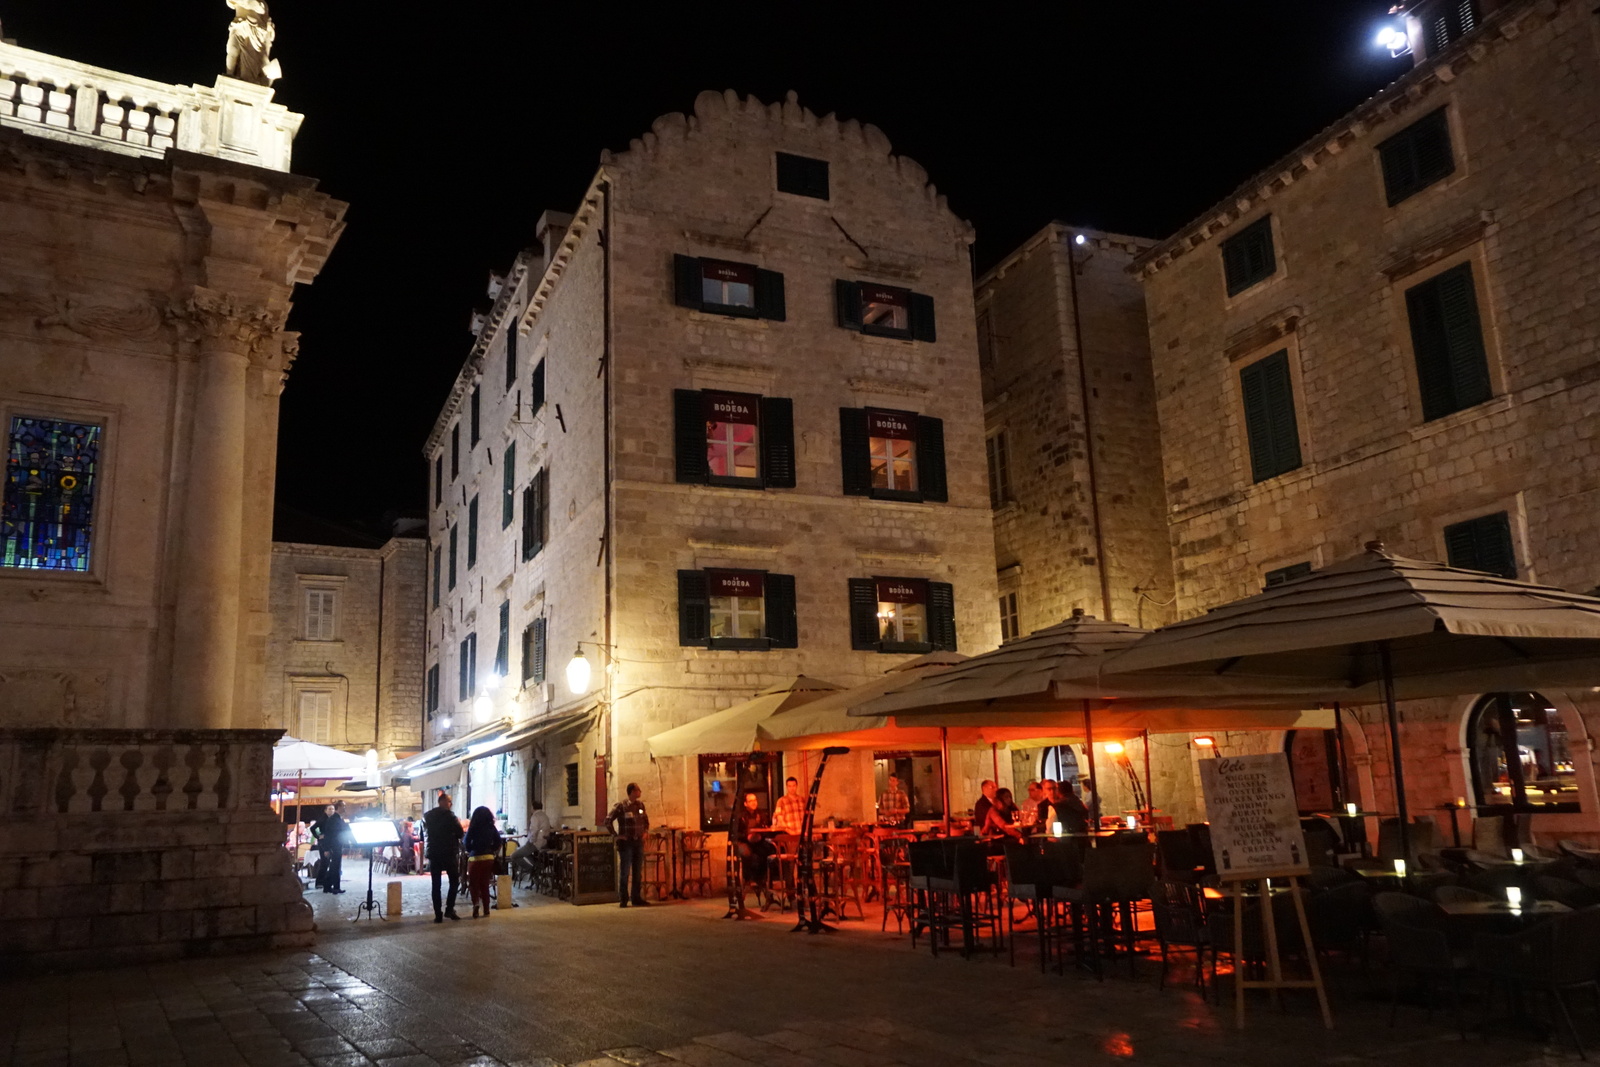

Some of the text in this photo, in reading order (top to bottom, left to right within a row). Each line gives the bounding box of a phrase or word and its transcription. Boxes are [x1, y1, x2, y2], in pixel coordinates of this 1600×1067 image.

[713, 403, 749, 414] BODEGA
[876, 420, 908, 431] BODEGA
[722, 579, 750, 587] BODEGA
[888, 587, 914, 595] BODEGA
[1225, 773, 1267, 782] NUGGETS
[1227, 780, 1267, 789] MUSSELS
[1228, 787, 1269, 796] OYSTERS
[1214, 793, 1286, 804] CHICKEN WINGS
[1233, 801, 1268, 810] SHRIMP
[1240, 816, 1267, 824] PIZZA
[1234, 823, 1276, 832] BURGERS
[1239, 830, 1274, 839] SALADS
[1233, 837, 1282, 847] ICE CREAM
[1242, 845, 1277, 854] CREPES
